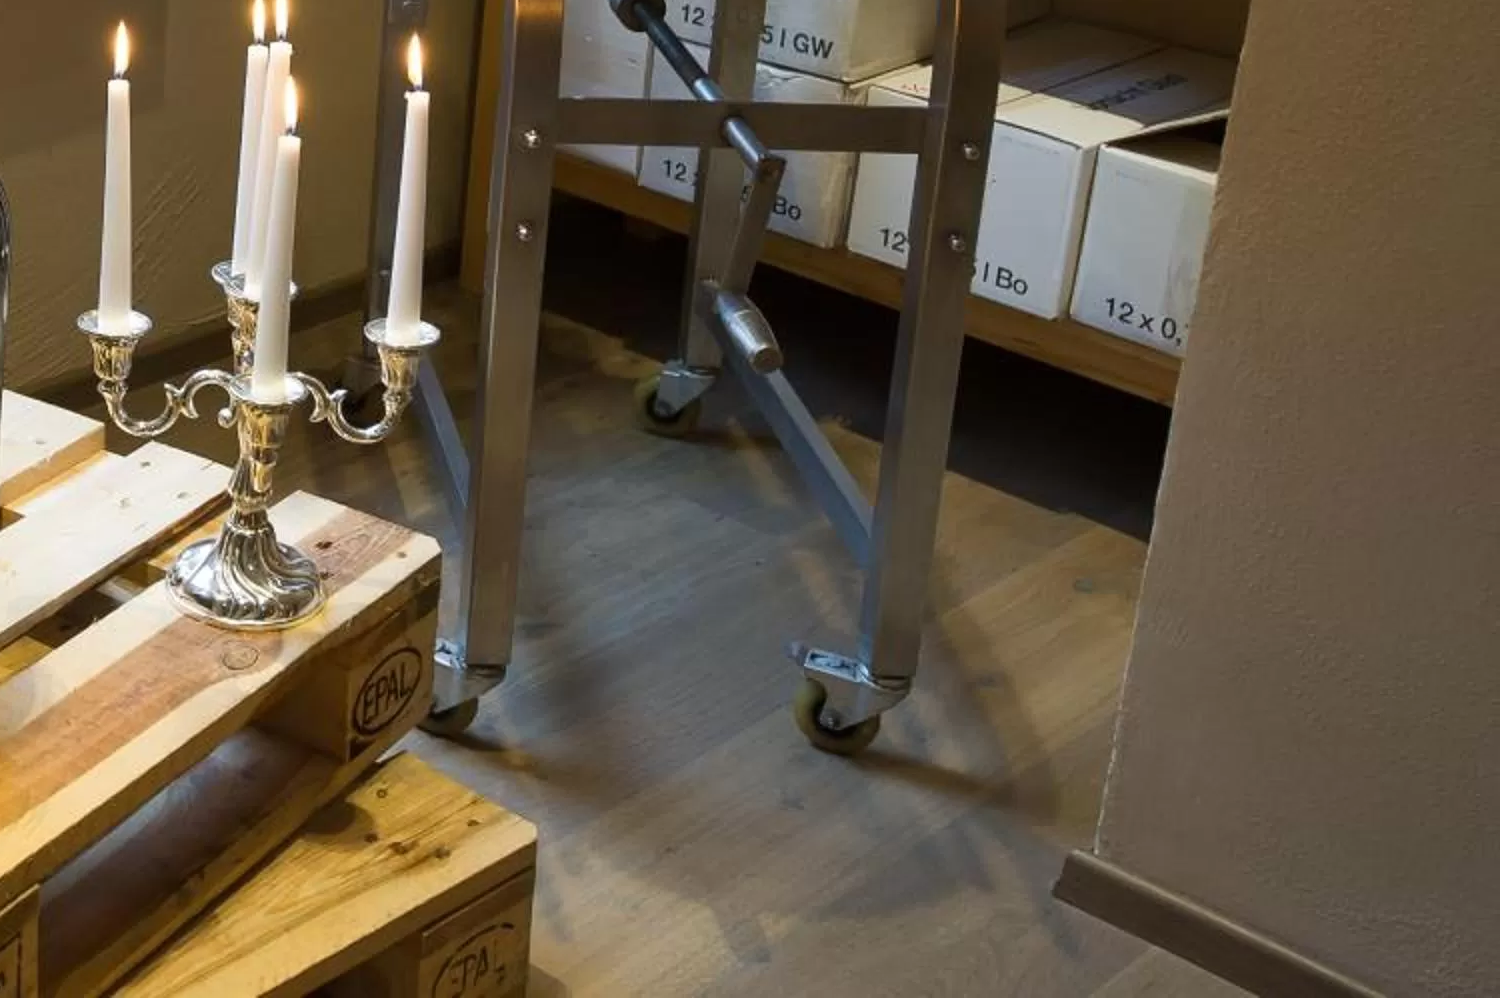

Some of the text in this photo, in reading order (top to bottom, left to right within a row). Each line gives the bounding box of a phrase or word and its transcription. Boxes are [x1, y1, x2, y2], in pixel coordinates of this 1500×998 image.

[793, 32, 834, 59] GW
[663, 159, 687, 183] 12
[995, 266, 1029, 296] Bo
[1105, 297, 1189, 347] 12 x 0,
[362, 661, 414, 725] EPAL
